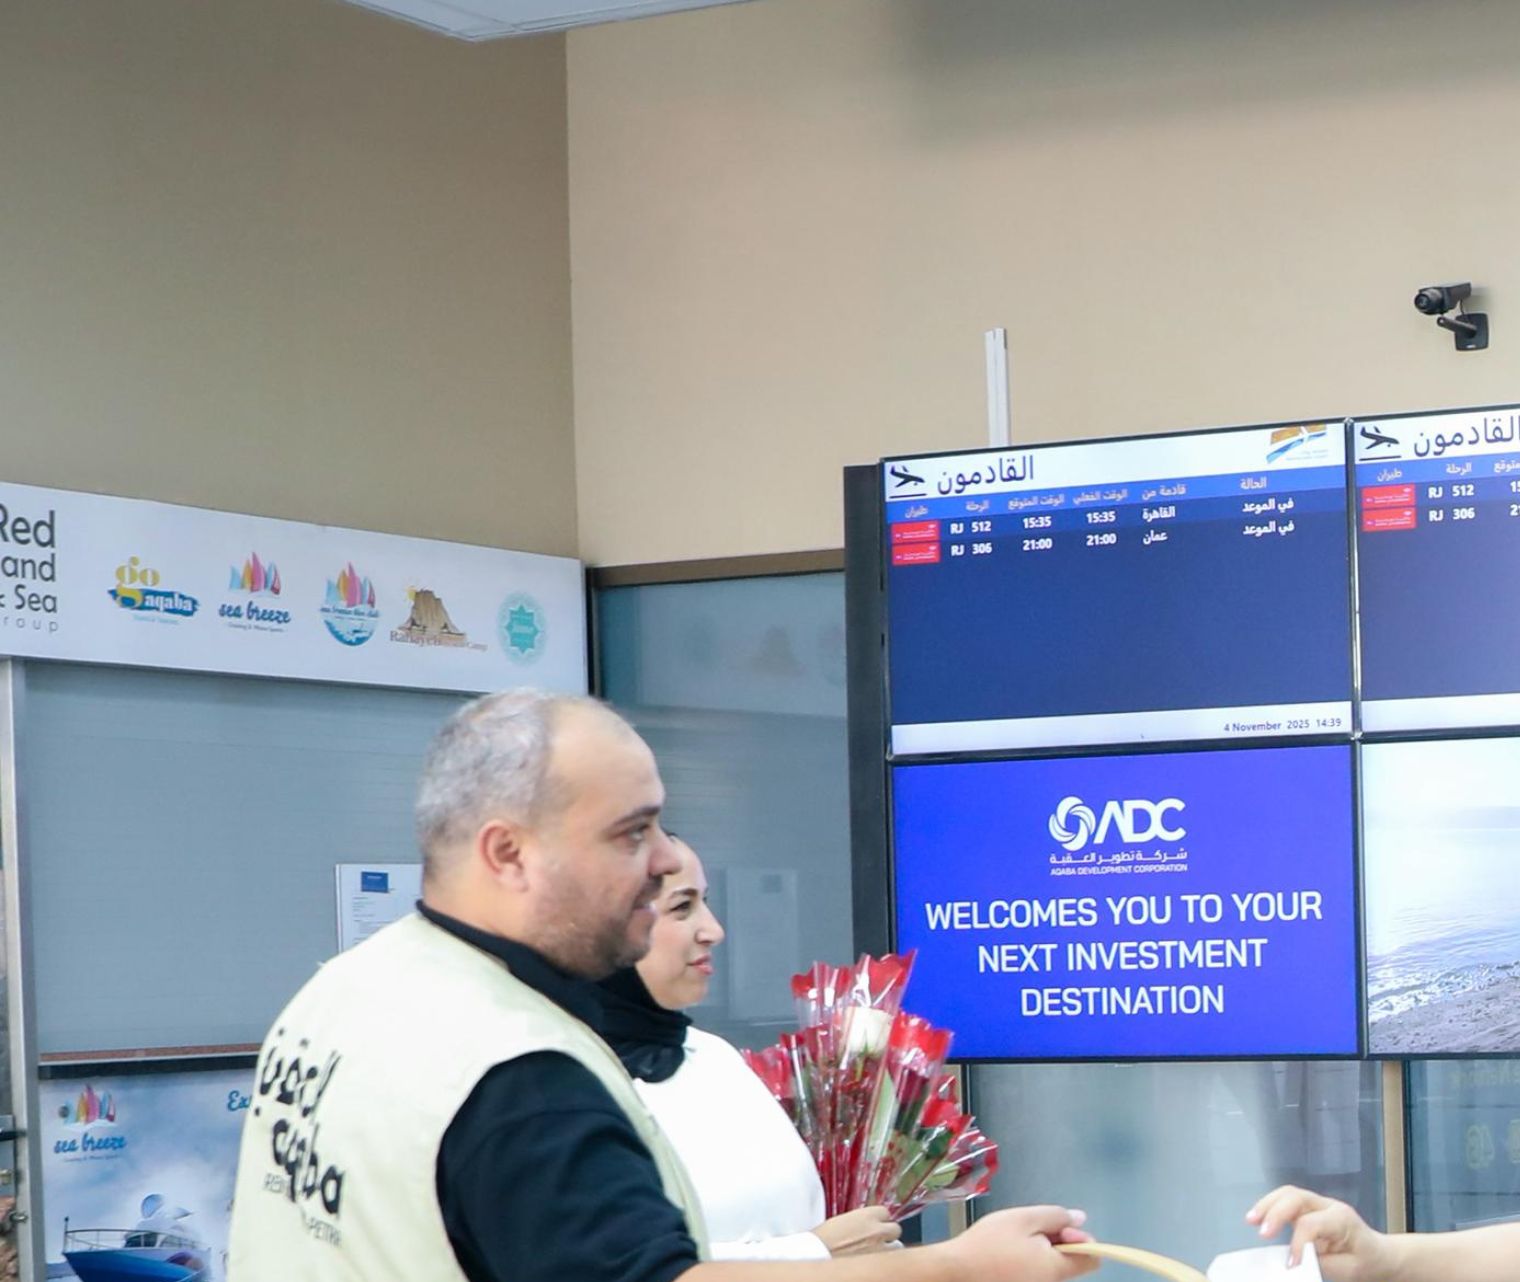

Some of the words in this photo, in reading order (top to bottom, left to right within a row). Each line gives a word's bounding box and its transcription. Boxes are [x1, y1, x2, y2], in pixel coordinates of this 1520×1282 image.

[937, 455, 1035, 496] القادمون
[1428, 487, 1443, 499] RJ
[1452, 484, 1475, 497] 512
[1023, 516, 1051, 529] 15:35
[1086, 511, 1116, 524] 15:35
[1429, 510, 1443, 522] RJ
[1452, 507, 1475, 520] 306
[950, 523, 964, 535] RJ
[971, 521, 992, 533] 512
[1023, 538, 1053, 551] 21:00
[1086, 533, 1117, 547] 21:00
[951, 545, 965, 557] RJ
[971, 543, 993, 555] 306
[1, 552, 56, 582] and
[14, 584, 58, 613] Sea
[218, 602, 243, 619] sea
[246, 600, 292, 625] breeze
[2, 615, 59, 633] roup
[1223, 723, 1230, 732] 4
[1232, 720, 1282, 732] November
[1287, 719, 1310, 729] 2025
[1316, 717, 1342, 728] 14:39
[1093, 798, 1187, 844] ADC
[1050, 866, 1077, 876] AQABA
[1077, 865, 1133, 876] DEVELOPMENT
[1133, 863, 1188, 873] CORPORATION
[925, 897, 1098, 931] WELCOMES
[1106, 894, 1173, 925] YOU
[1180, 893, 1223, 923] TO
[1231, 891, 1323, 922] YOUR
[978, 943, 1059, 974] NEXT
[1067, 937, 1268, 971] INVESTMENT
[1021, 985, 1225, 1017] DESTINATION
[227, 1090, 252, 1112] Ex
[54, 1137, 79, 1154] sea
[81, 1132, 127, 1152] breeze
